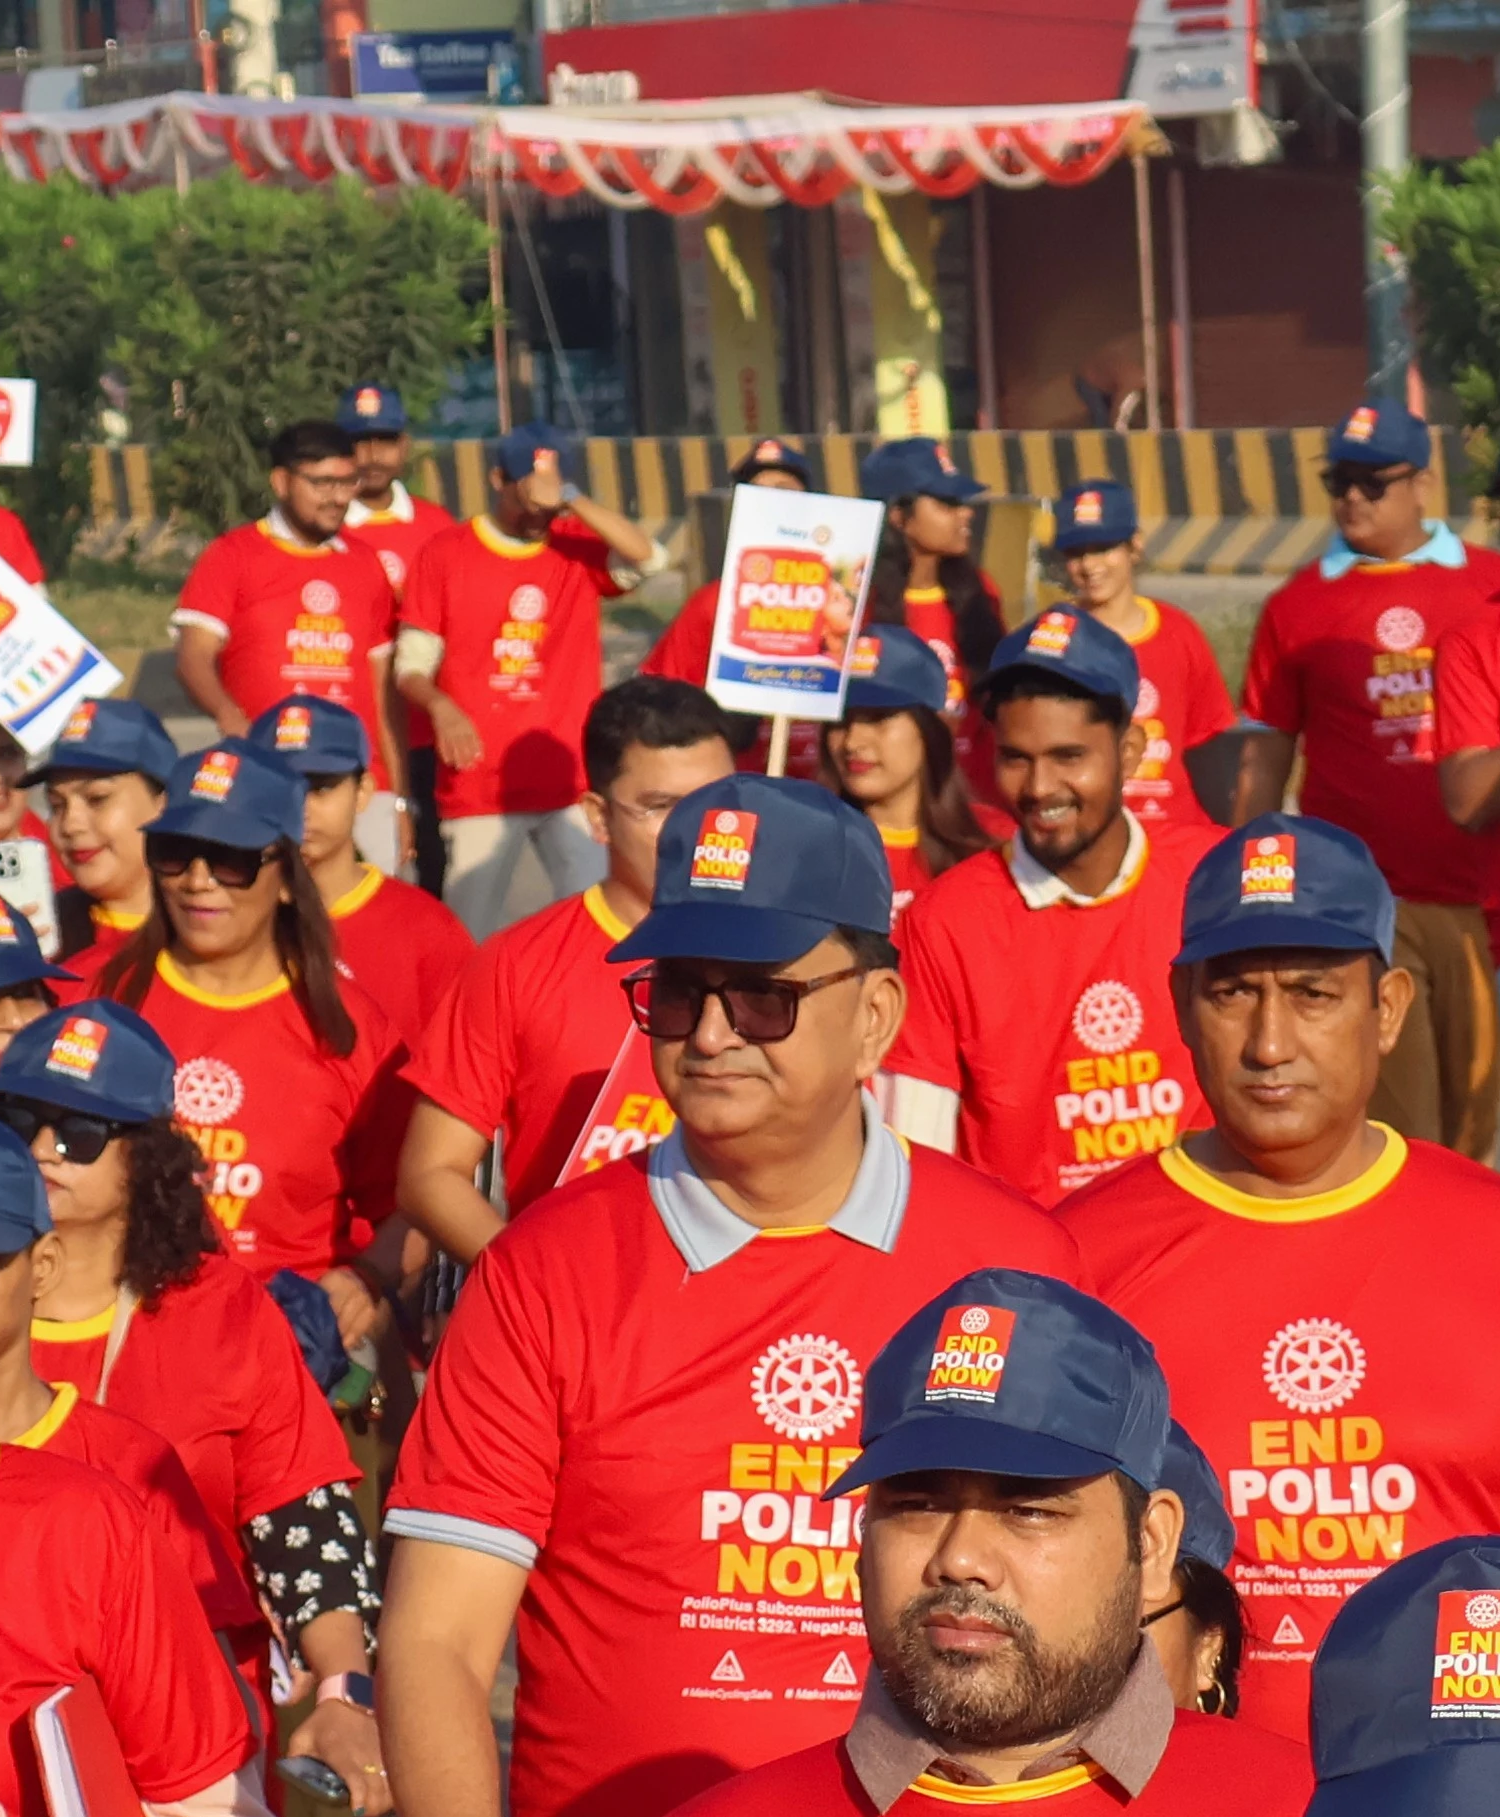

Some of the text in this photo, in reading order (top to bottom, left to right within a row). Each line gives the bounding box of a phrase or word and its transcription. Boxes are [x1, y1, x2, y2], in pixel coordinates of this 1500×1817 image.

[774, 559, 826, 584] END
[738, 583, 825, 609] POLIO
[749, 606, 815, 631] NOW
[1067, 1050, 1159, 1092] END
[1056, 1080, 1183, 1129] POLIO
[1074, 1114, 1180, 1166] NOW
[931, 1350, 1004, 1372] POLIO
[944, 1334, 998, 1354] END
[933, 1366, 995, 1386] NOW
[1250, 1416, 1383, 1467] END
[730, 1444, 863, 1494] END
[1229, 1464, 1416, 1516] POLIO
[702, 1491, 864, 1548] POLI
[1255, 1512, 1405, 1562] NOW
[718, 1544, 861, 1600] NOW
[680, 1614, 755, 1633] RI District
[682, 1597, 753, 1614] PolioPlus
